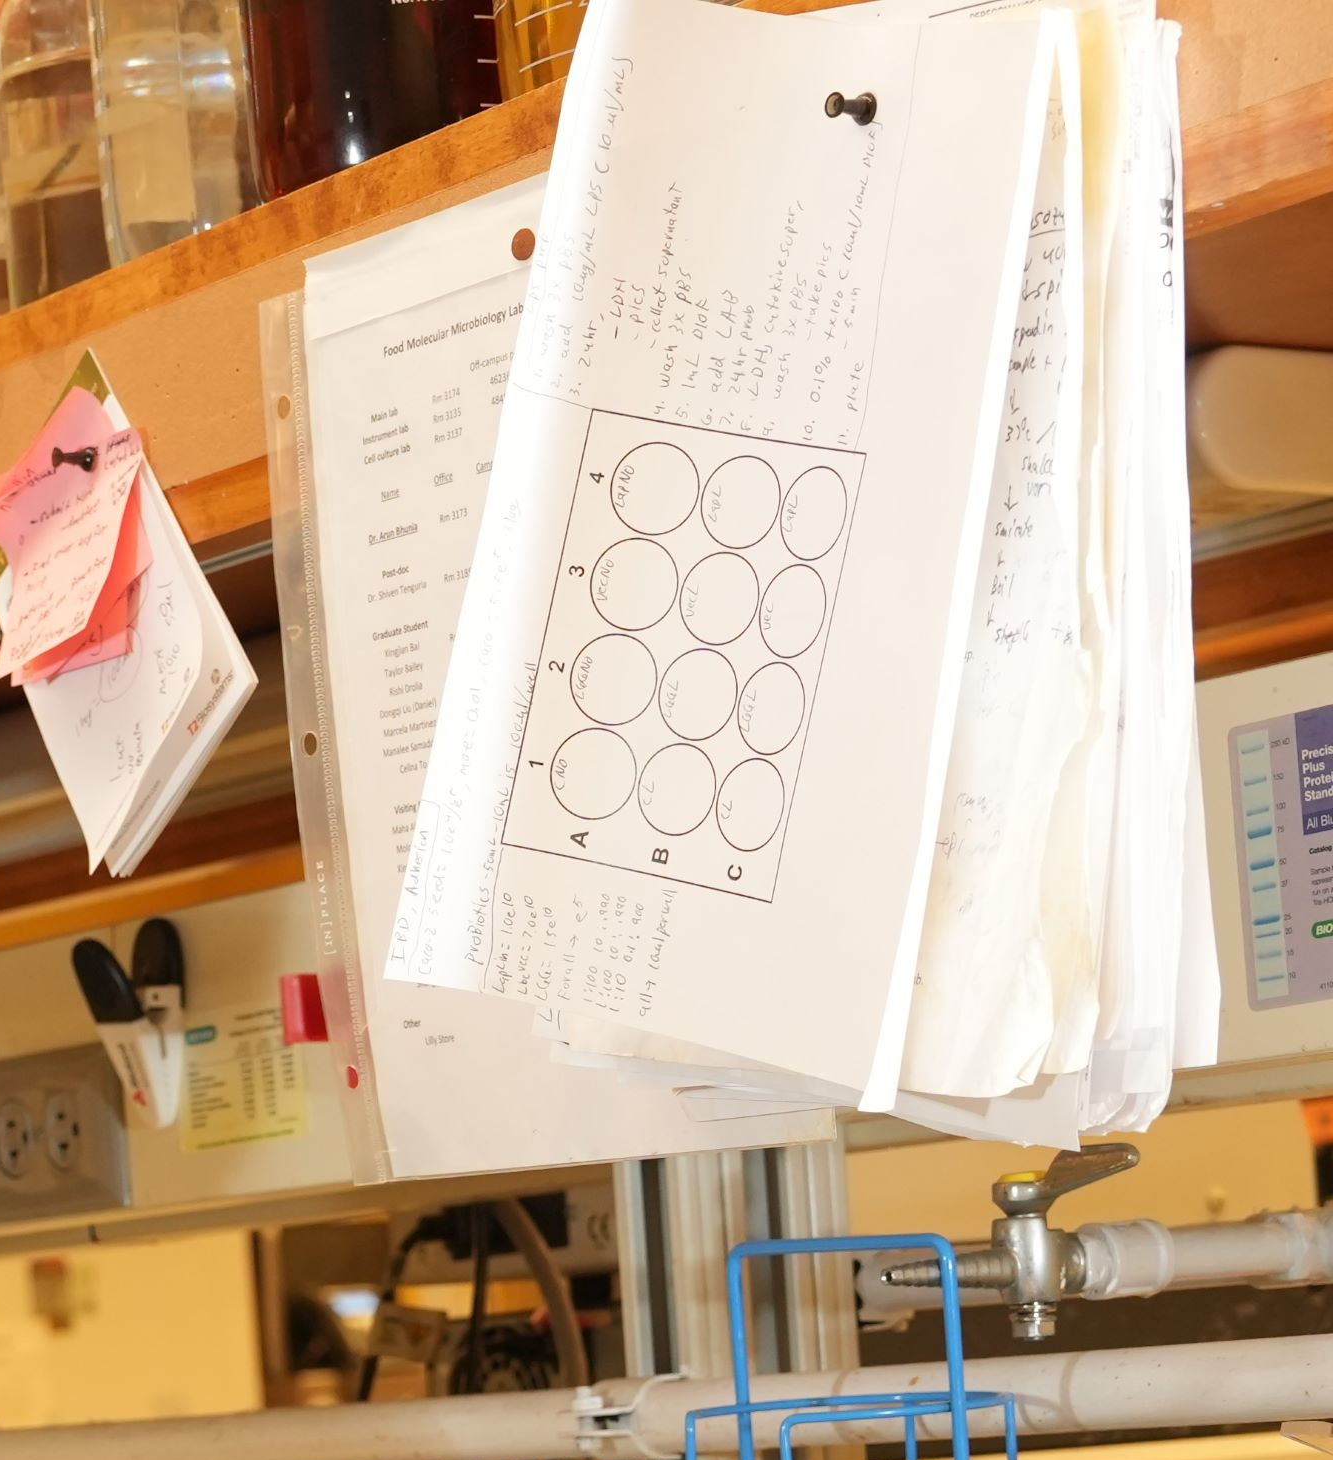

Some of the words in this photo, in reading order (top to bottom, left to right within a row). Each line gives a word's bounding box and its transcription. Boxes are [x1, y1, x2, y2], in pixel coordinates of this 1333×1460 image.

[383, 341, 404, 358] Food
[407, 329, 449, 351] Molecular
[451, 309, 506, 336] Microbiology
[509, 302, 524, 317] Lab
[660, 343, 678, 387] wash
[677, 265, 692, 304] PBS
[558, 324, 574, 359] add
[774, 352, 792, 399] wash
[790, 273, 808, 310] PBS
[470, 353, 508, 371] Off-campus
[709, 356, 725, 392] add
[444, 388, 460, 401] 3174
[371, 412, 387, 423] Main
[389, 407, 398, 418] lab
[446, 408, 461, 421] 3135
[363, 428, 398, 445] Instrument
[399, 424, 409, 435] lab
[447, 427, 463, 441] 3137
[364, 453, 376, 465] Cell
[377, 447, 400, 461] culture
[401, 443, 411, 454] lab
[589, 471, 606, 484] 4
[381, 488, 400, 501] Name
[433, 472, 453, 486] Office
[368, 534, 378, 544] Dr.
[396, 522, 418, 537] Bhunia
[452, 507, 468, 521] 3173
[382, 565, 409, 579] Post-doc
[568, 564, 585, 577] 3
[379, 586, 399, 601] Shiven
[373, 628, 402, 641] Graduate
[403, 620, 429, 633] Student
[384, 667, 404, 678] Taylor
[405, 662, 423, 674] Bailey
[548, 660, 565, 672] 2
[383, 722, 408, 738] Marcela
[383, 745, 410, 758] Manalee
[400, 761, 418, 774] Celina
[528, 759, 545, 768] 1
[1303, 762, 1325, 774] Plus
[394, 802, 418, 815] Visiting
[1307, 817, 1318, 830] All
[569, 830, 590, 848] A
[651, 847, 670, 864] B
[1309, 845, 1332, 855] Catalog
[727, 864, 744, 881] C
[403, 1019, 421, 1029] Other
[425, 1036, 437, 1047] Lilly
[438, 1034, 455, 1045] Store
